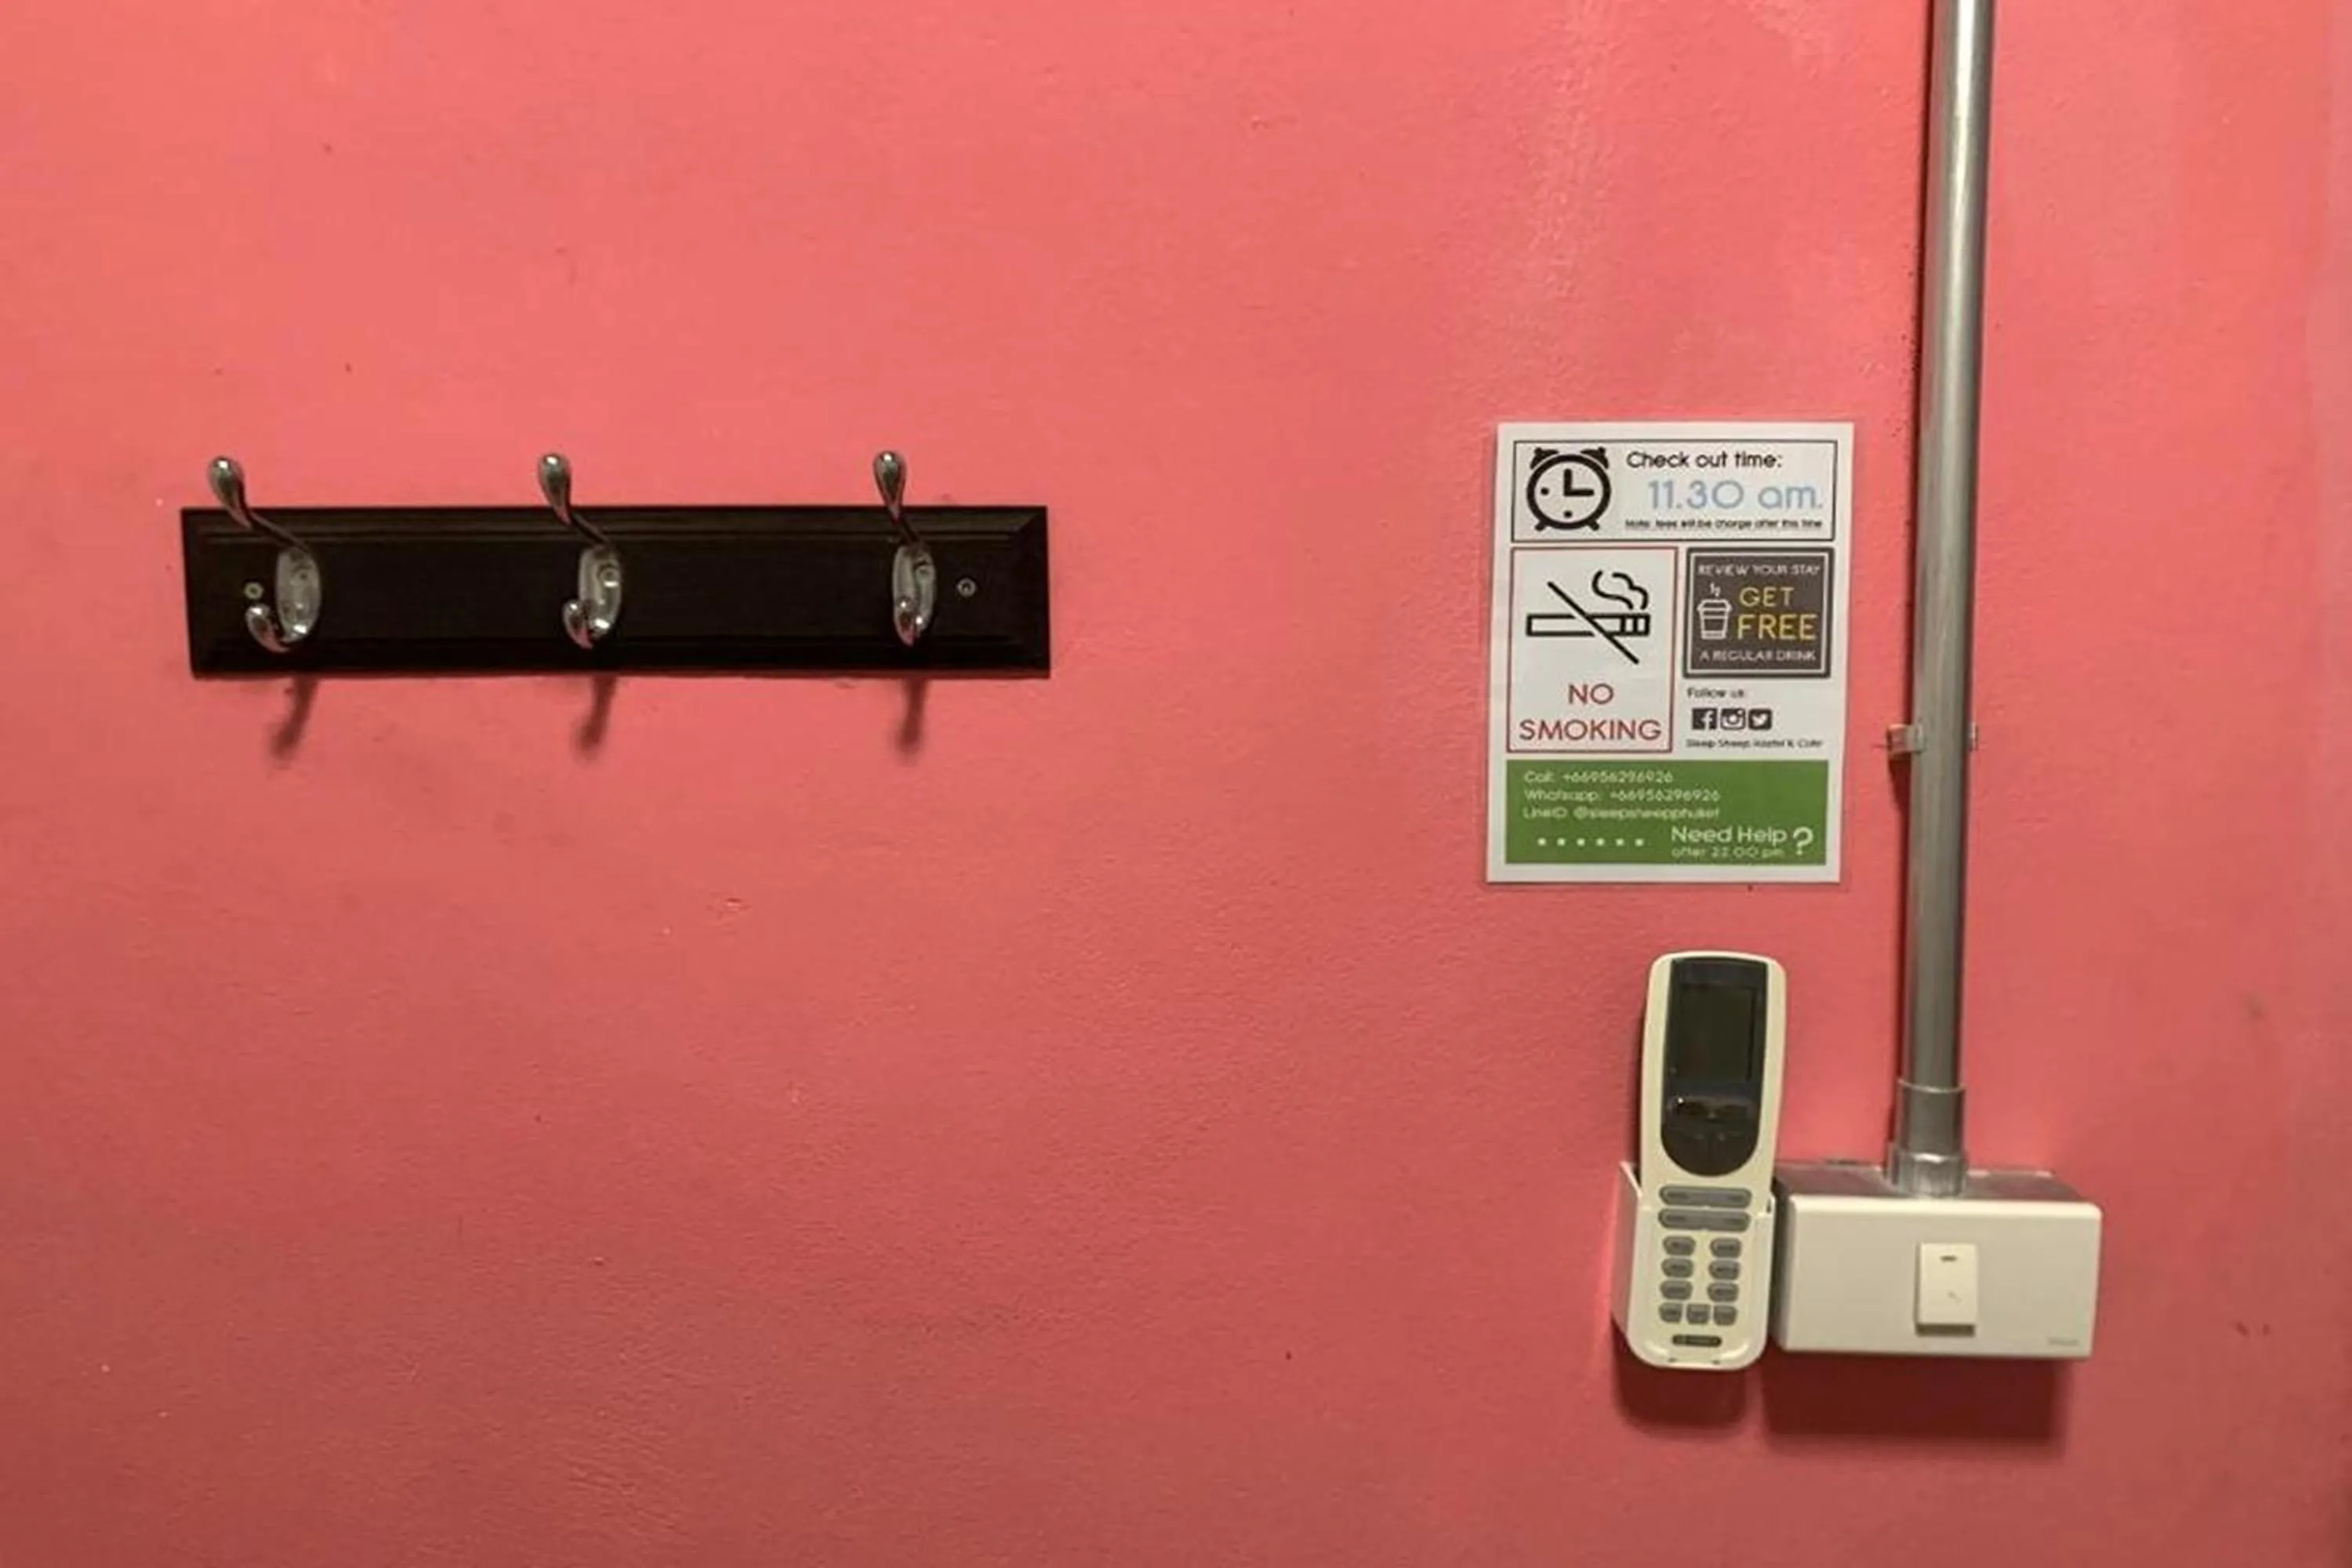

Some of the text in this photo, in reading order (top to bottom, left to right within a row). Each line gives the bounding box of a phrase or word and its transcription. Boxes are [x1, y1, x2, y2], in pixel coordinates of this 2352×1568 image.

[1626, 451, 1783, 468] Check out time:
[1649, 479, 1823, 510] 11.30 am.
[1697, 564, 1820, 575] REVIEW YOUR STAY
[1739, 586, 1794, 607] GET
[1737, 614, 1817, 640] FREE
[1700, 650, 1816, 661] A REGULAR DRINK
[1569, 683, 1614, 705] NO
[1687, 688, 1726, 698] Follow
[1519, 719, 1661, 741] SMOKING
[1671, 826, 1814, 855] Need Help ?
[1671, 847, 1705, 857] after
